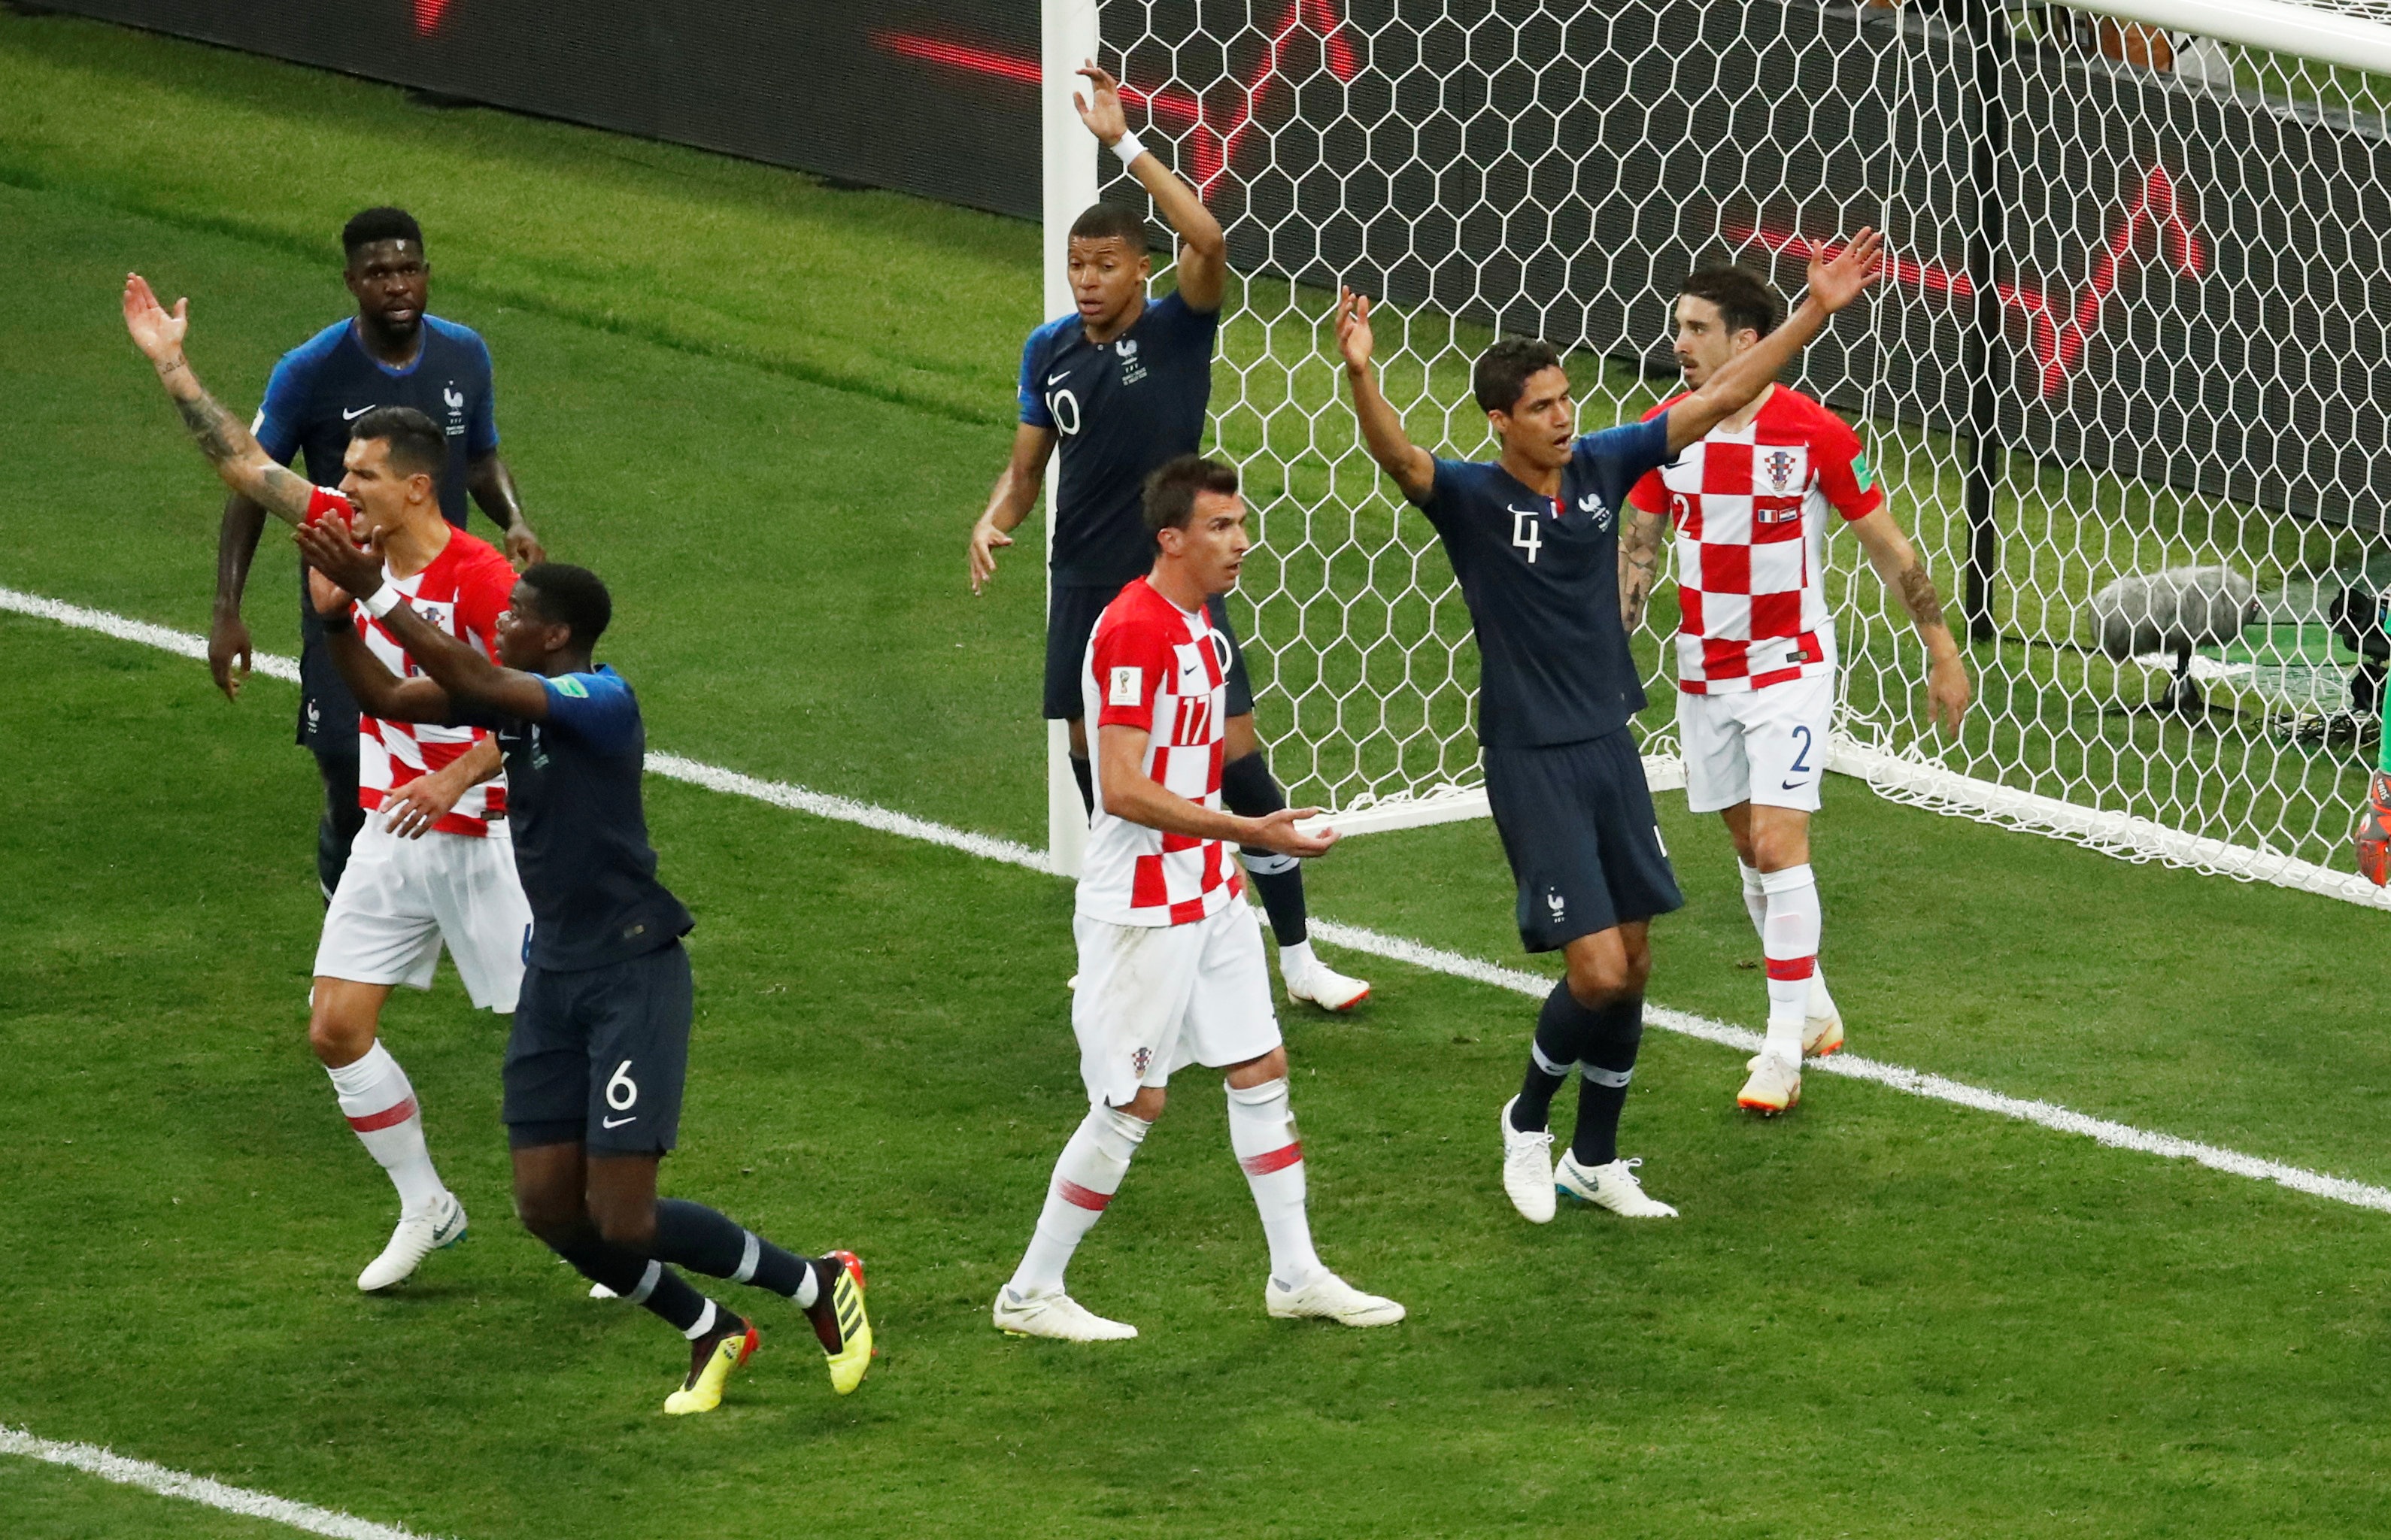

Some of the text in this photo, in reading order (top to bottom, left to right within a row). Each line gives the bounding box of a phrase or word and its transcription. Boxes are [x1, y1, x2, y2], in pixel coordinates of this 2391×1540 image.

[1045, 388, 1081, 438] 10
[1512, 515, 1542, 563] 4
[1673, 493, 1692, 538] 2
[1179, 696, 1211, 746] 17
[1791, 725, 1810, 772] 2
[605, 1060, 638, 1111] 6
